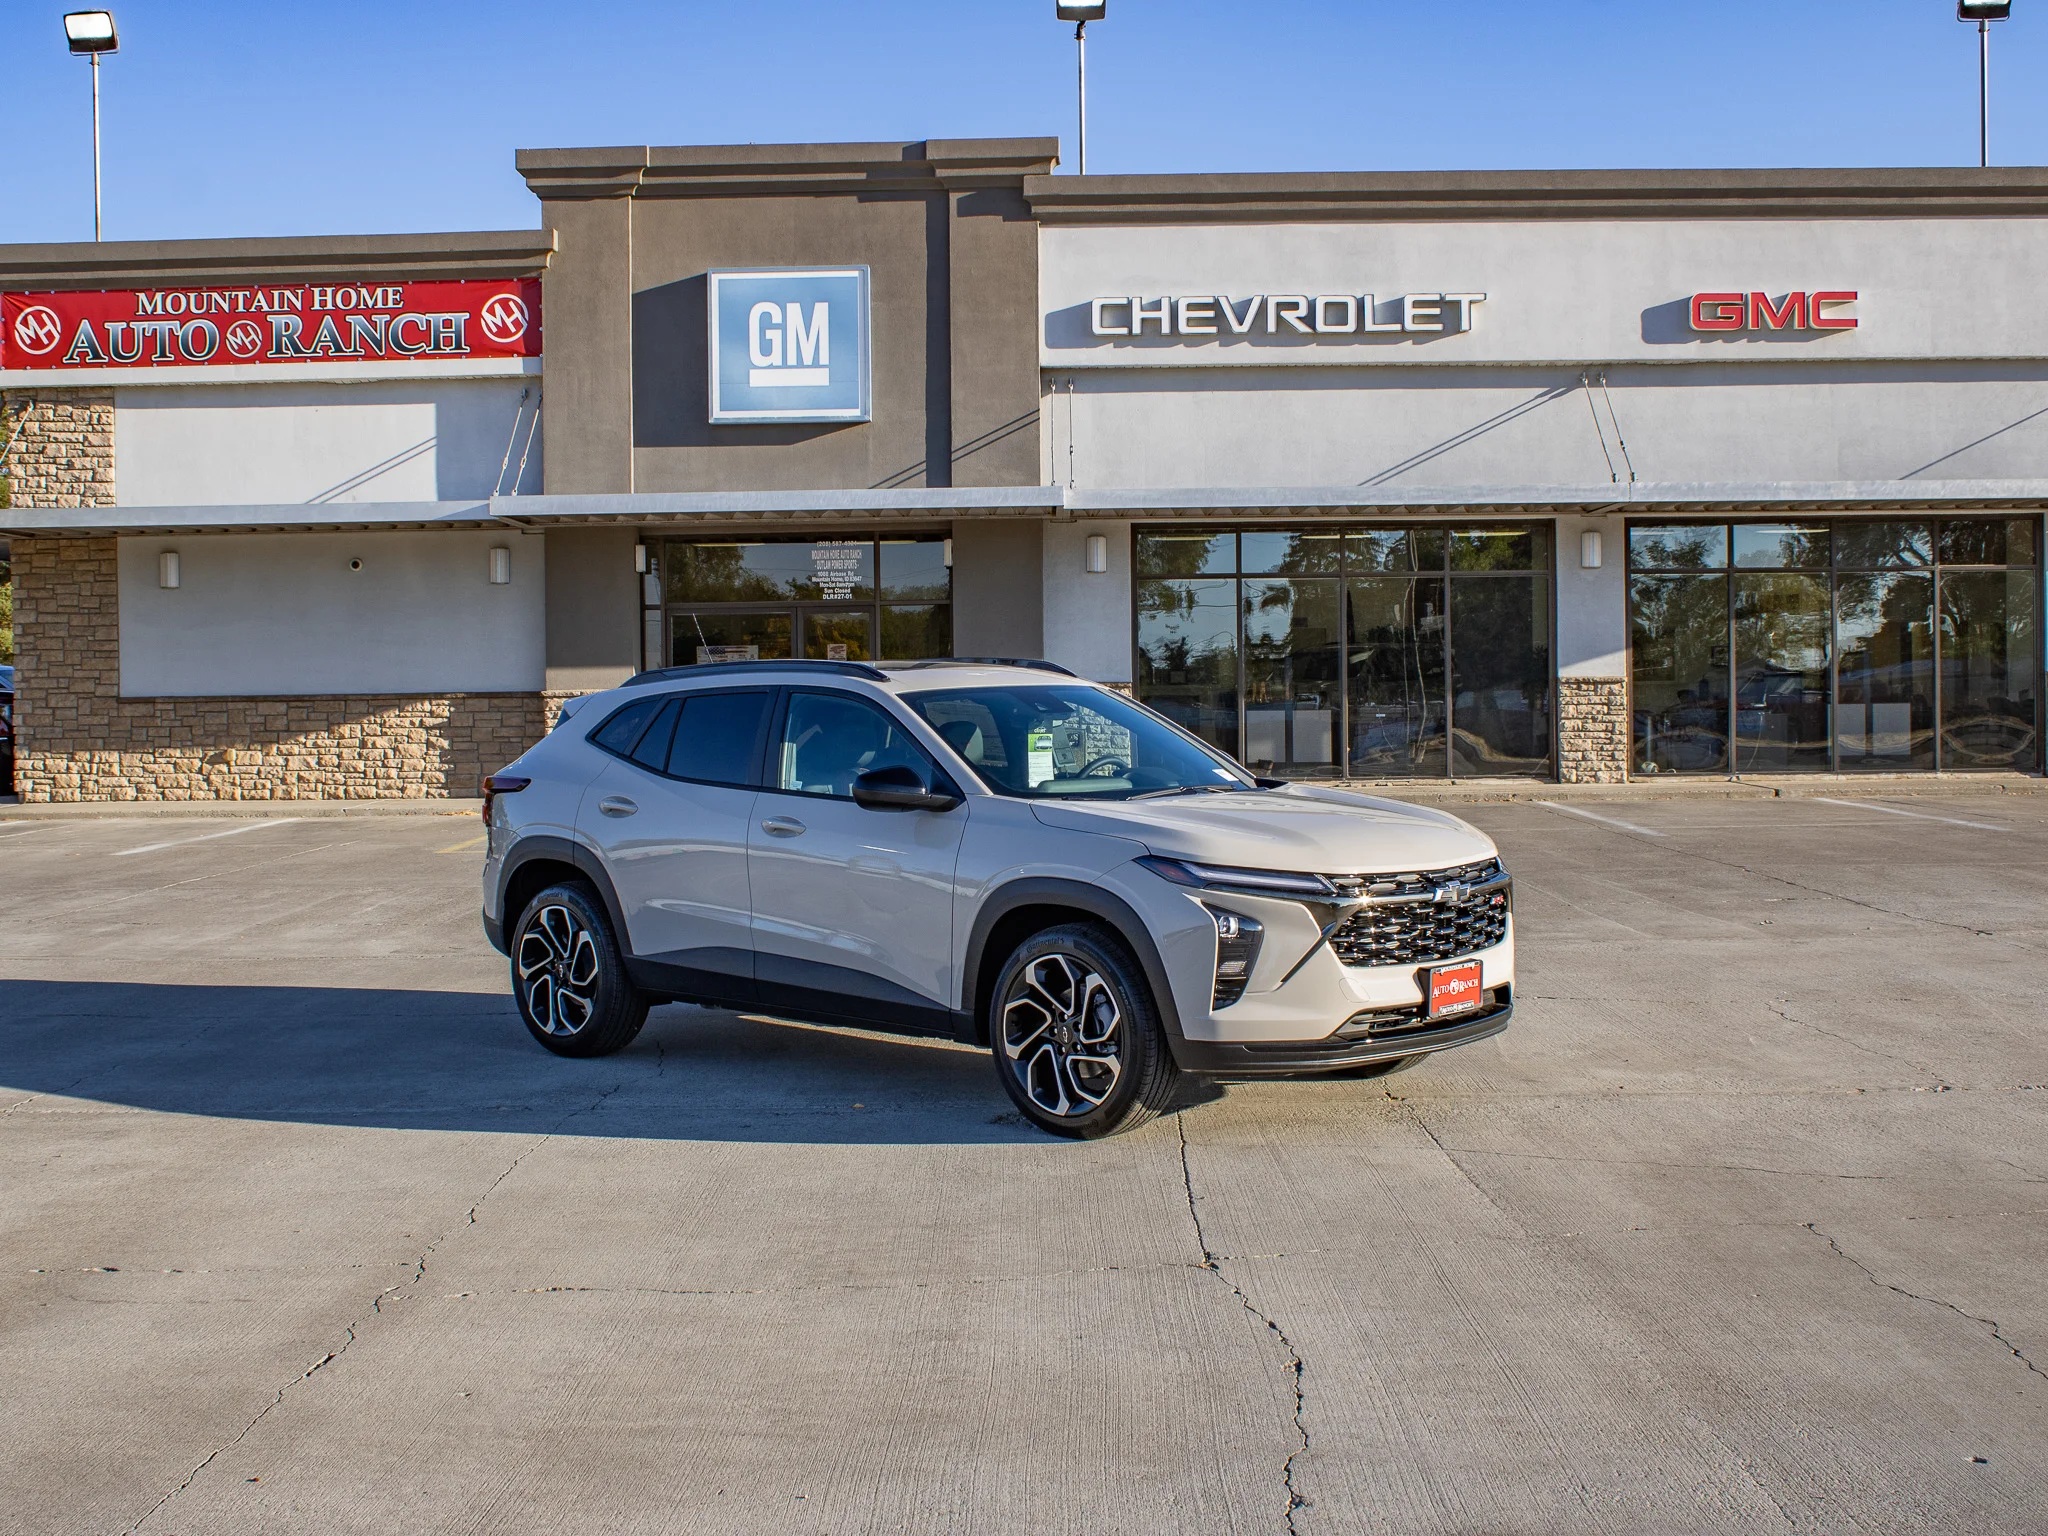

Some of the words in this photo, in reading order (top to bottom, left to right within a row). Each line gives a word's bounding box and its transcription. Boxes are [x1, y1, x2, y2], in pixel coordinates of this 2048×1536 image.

[135, 288, 304, 315] MOUNTAIN
[311, 287, 404, 311] HOME
[1091, 292, 1487, 335] CHEVROLET
[1689, 291, 1858, 331] GMC
[62, 318, 220, 364] AUTO
[266, 312, 471, 358] RANCH
[748, 301, 830, 367] GM
[1432, 984, 1450, 998] AUTO
[1459, 978, 1479, 993] RANCH
